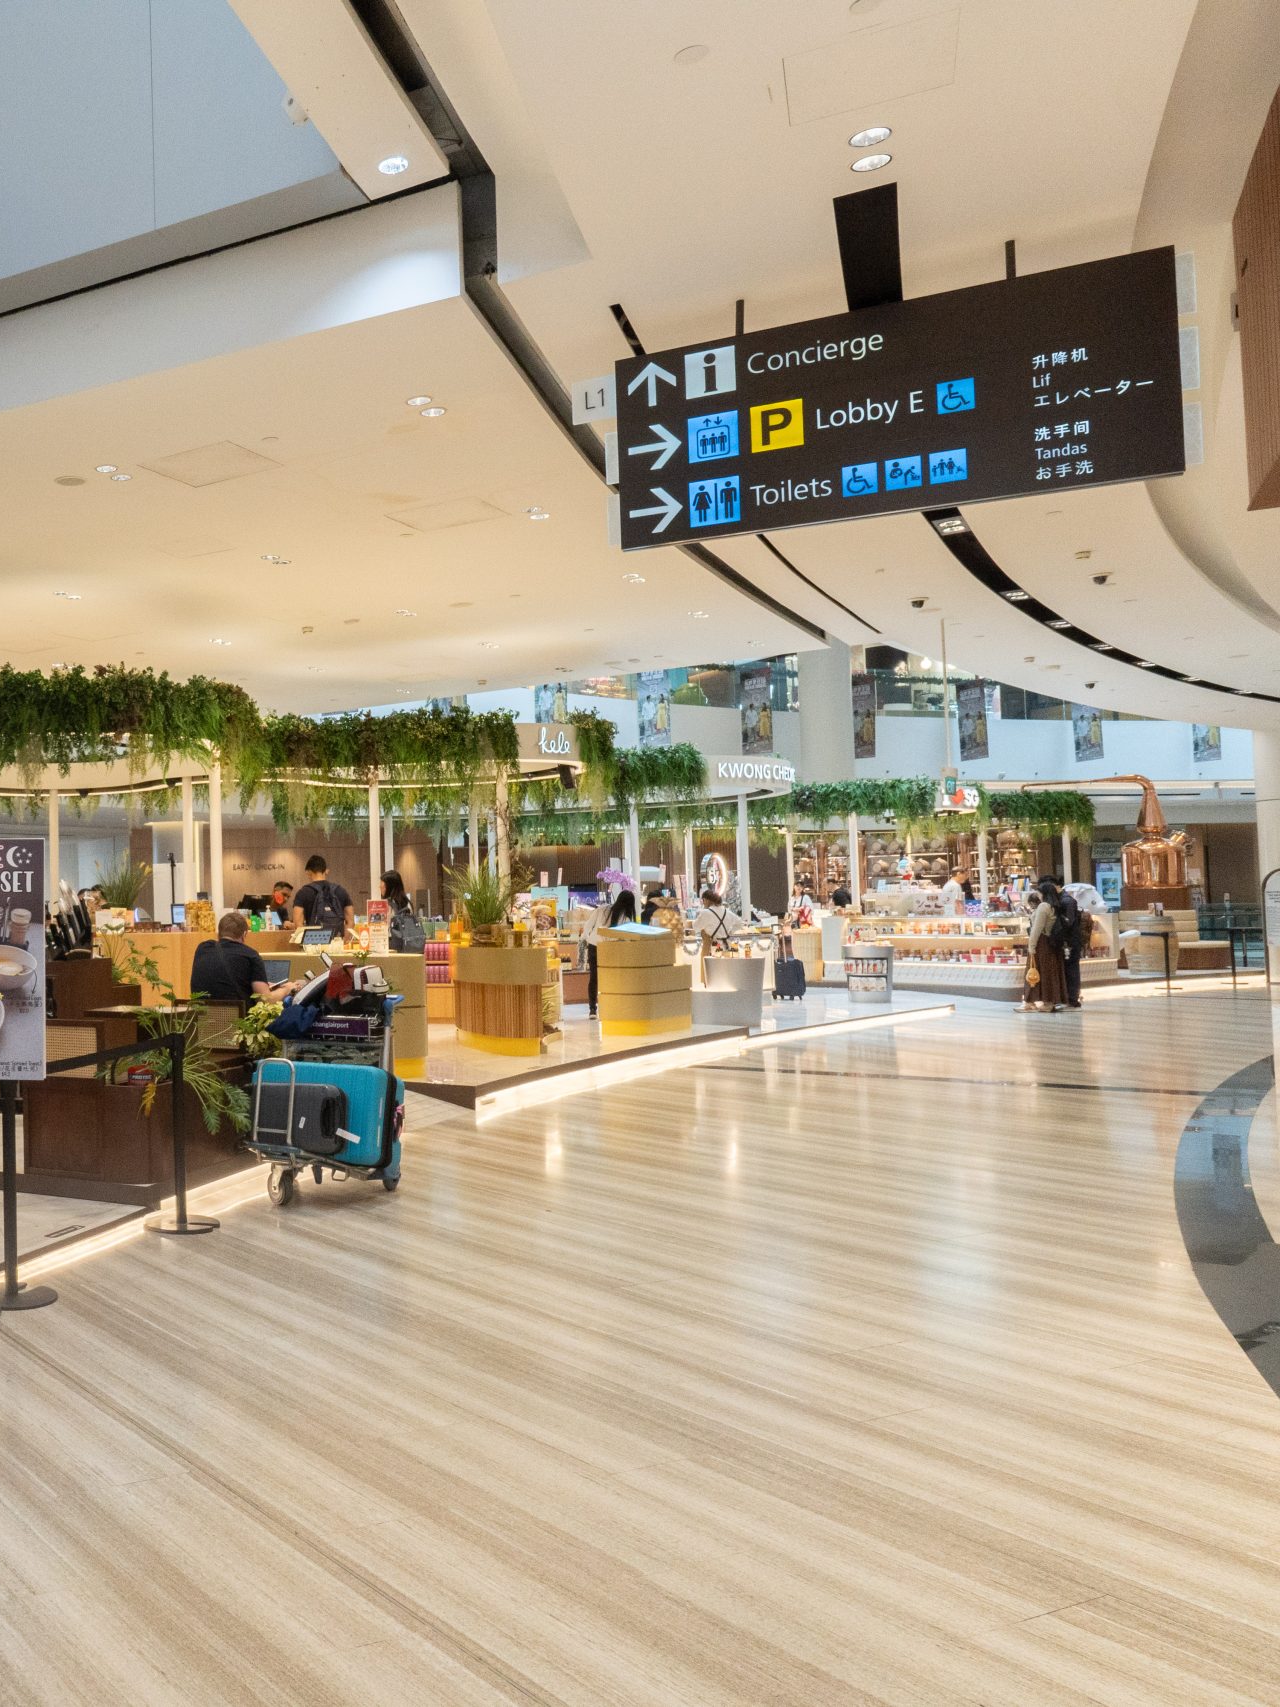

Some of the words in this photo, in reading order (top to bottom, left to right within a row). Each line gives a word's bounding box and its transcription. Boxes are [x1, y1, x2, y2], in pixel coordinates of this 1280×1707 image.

[746, 333, 885, 375] Concierge
[1031, 347, 1089, 370] 升降机
[1032, 373, 1051, 389] Lif
[584, 388, 605, 410] L1
[1033, 379, 1154, 407] エレベーター
[815, 398, 899, 431] Lobby
[910, 391, 925, 414] E
[761, 407, 793, 446] P
[1034, 420, 1090, 442] 洗手间
[1035, 443, 1088, 460] Tandas
[1035, 460, 1094, 480] お手洗
[749, 478, 834, 507] Toilets
[537, 726, 571, 755] kele
[717, 762, 771, 780] KWONG
[0, 870, 35, 893] SET
